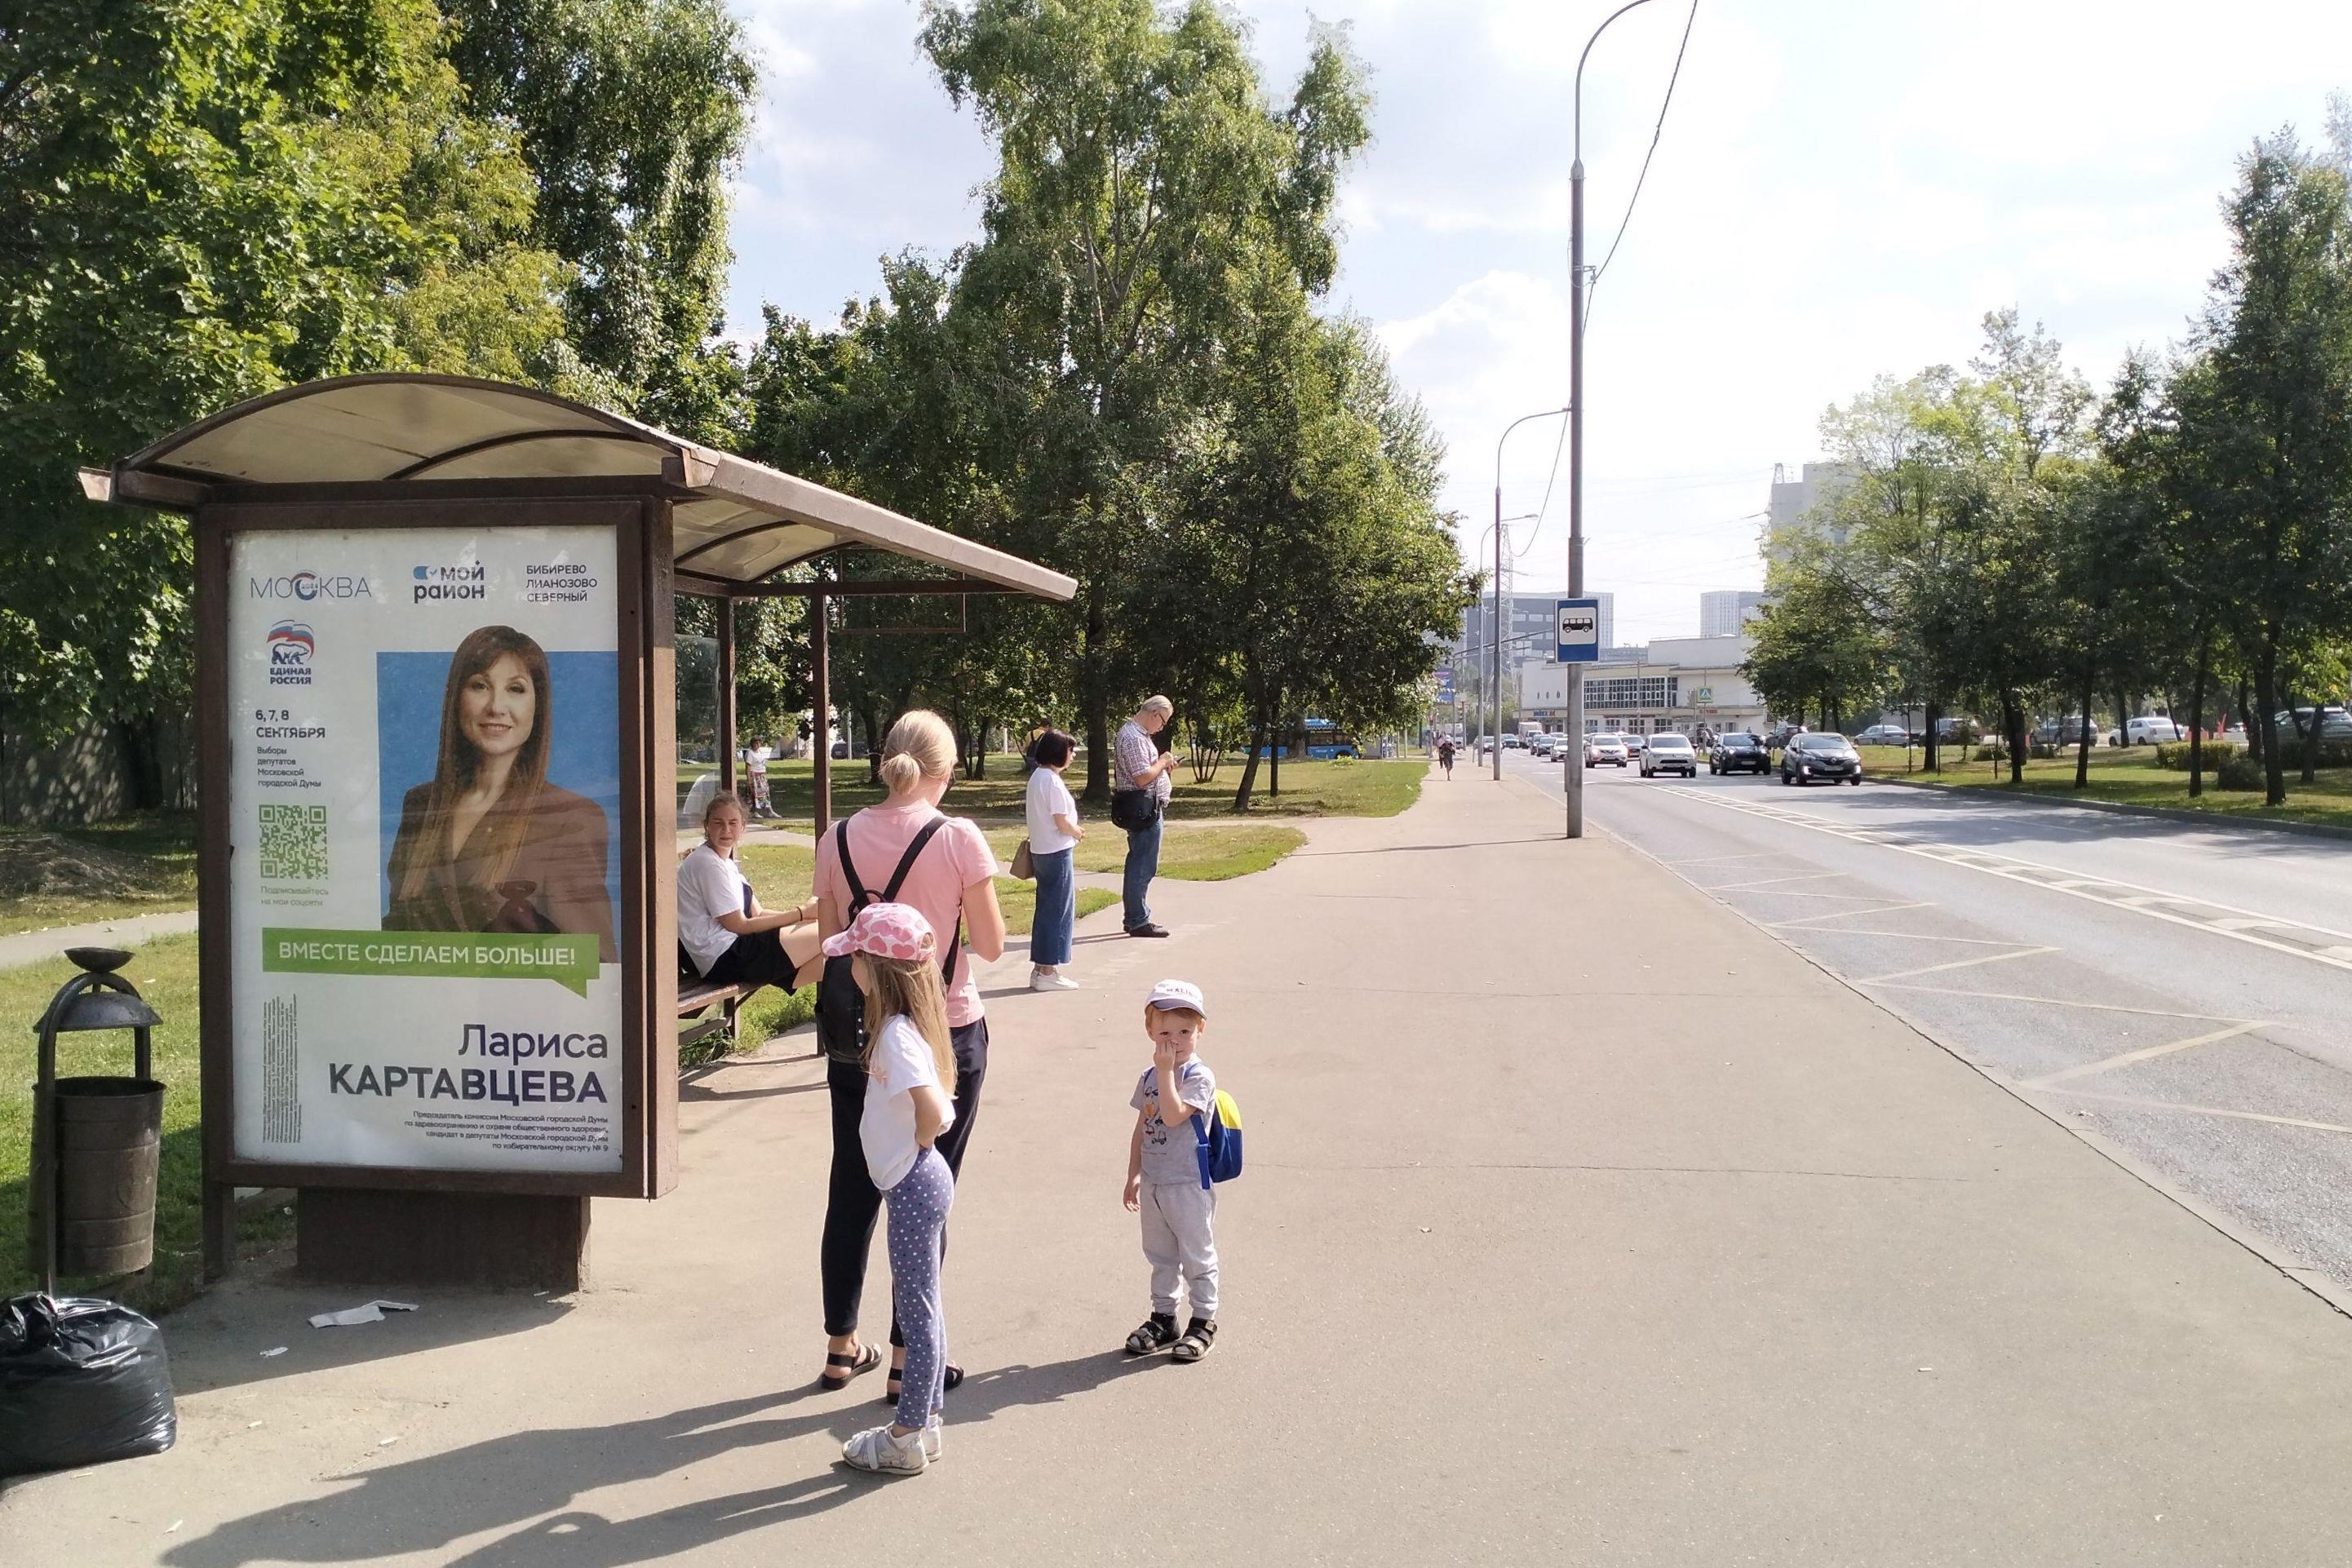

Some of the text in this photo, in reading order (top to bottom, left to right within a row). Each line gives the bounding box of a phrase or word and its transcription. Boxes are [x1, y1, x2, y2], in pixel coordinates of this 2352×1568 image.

[441, 560, 485, 581] мой
[526, 565, 587, 574] БИБИРЕВО
[250, 572, 372, 600] МОСКВА
[526, 578, 597, 588] ЛИАНОЗОВО
[527, 590, 587, 602] СЕВЕРНЫЙ
[270, 667, 311, 675] ЕДИНАЯ
[255, 710, 290, 722] 6, 7, 8
[256, 727, 326, 738] СЕНТЯБРЯ
[257, 746, 287, 755] Выборы
[257, 759, 296, 767] депутатов
[258, 779, 321, 789] городской Думы
[279, 941, 575, 966] ВМЕСТЕ СДЕЛАЕМ БОЛЬШЕ!
[458, 1024, 608, 1065] Лариса
[330, 1063, 608, 1106] КАРТАВЦЕВА
[547, 1115, 586, 1123] городской
[587, 1115, 608, 1123] Думы
[512, 1124, 570, 1132] общественного
[500, 1133, 546, 1141] Московской
